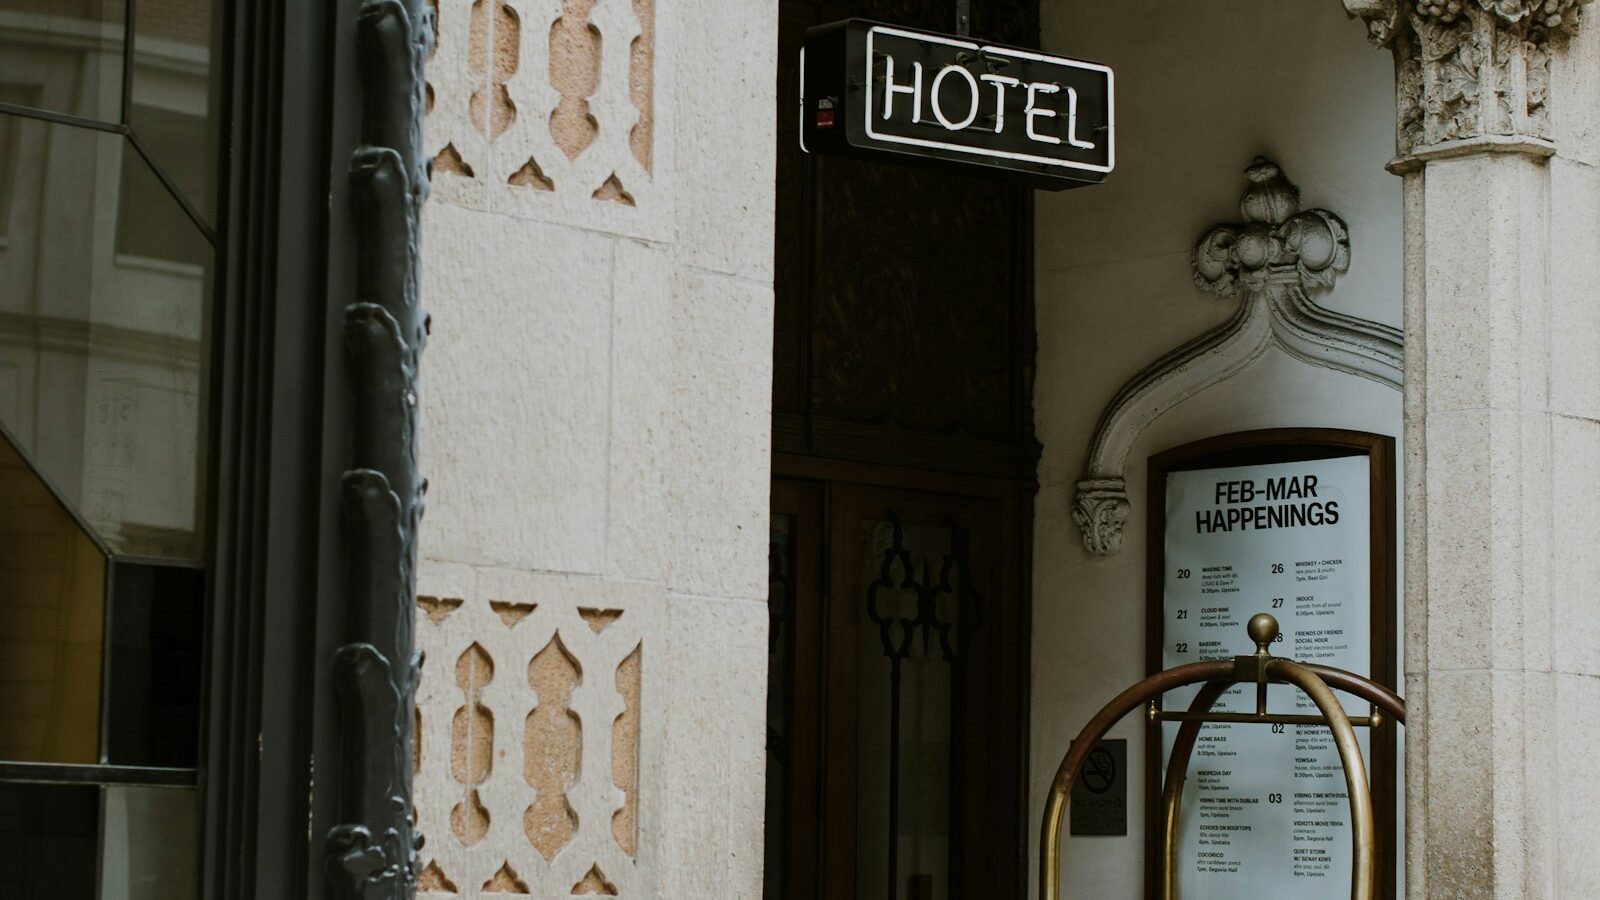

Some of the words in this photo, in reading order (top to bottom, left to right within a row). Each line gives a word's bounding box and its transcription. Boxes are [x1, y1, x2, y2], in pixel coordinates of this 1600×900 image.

[883, 54, 1096, 150] HOTEL
[1215, 475, 1318, 505] FEB-MAR
[1195, 501, 1339, 534] HAPPENINGS
[1177, 568, 1191, 579] 20
[1272, 564, 1284, 574] 26
[1272, 598, 1284, 608] 27
[1177, 610, 1187, 619] 21
[1176, 643, 1188, 652] 22
[1272, 724, 1284, 733] 02
[1269, 793, 1282, 804] 03
